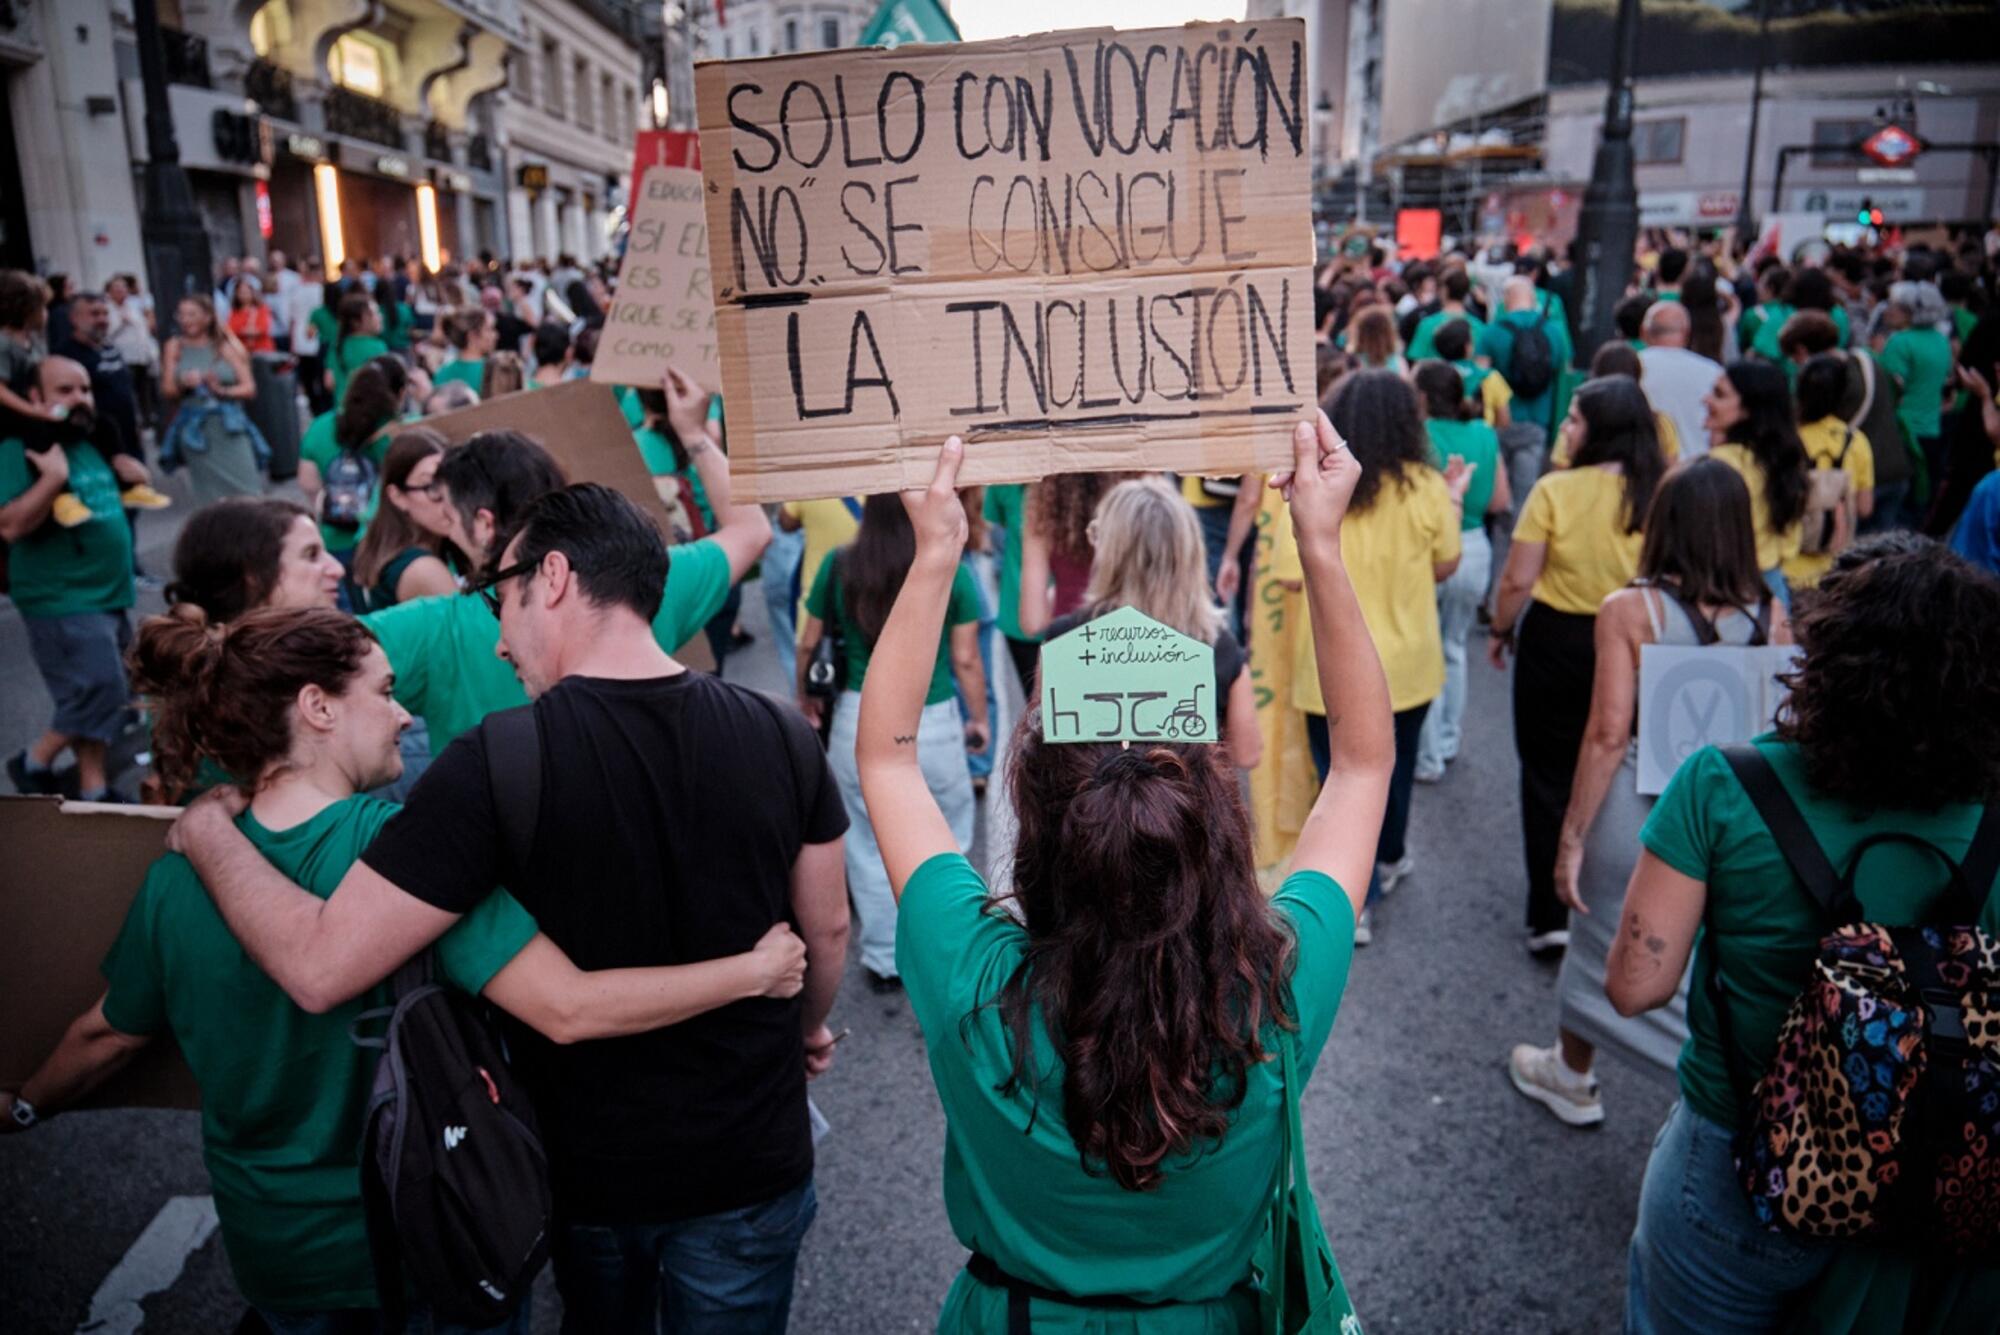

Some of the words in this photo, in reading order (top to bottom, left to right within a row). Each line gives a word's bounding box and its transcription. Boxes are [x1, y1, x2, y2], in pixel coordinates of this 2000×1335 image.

[727, 71, 926, 172] SOLO
[953, 69, 1053, 161] CON
[1062, 28, 1304, 162] VOCACIÓN
[630, 217, 666, 254] SI
[840, 174, 924, 276] SE
[968, 168, 1257, 275] CONSIGUE
[626, 265, 661, 290] ES
[669, 306, 700, 332] SE
[613, 338, 675, 360] COMO
[787, 309, 900, 421] LA
[945, 275, 1297, 416] INCLUSIÓN
